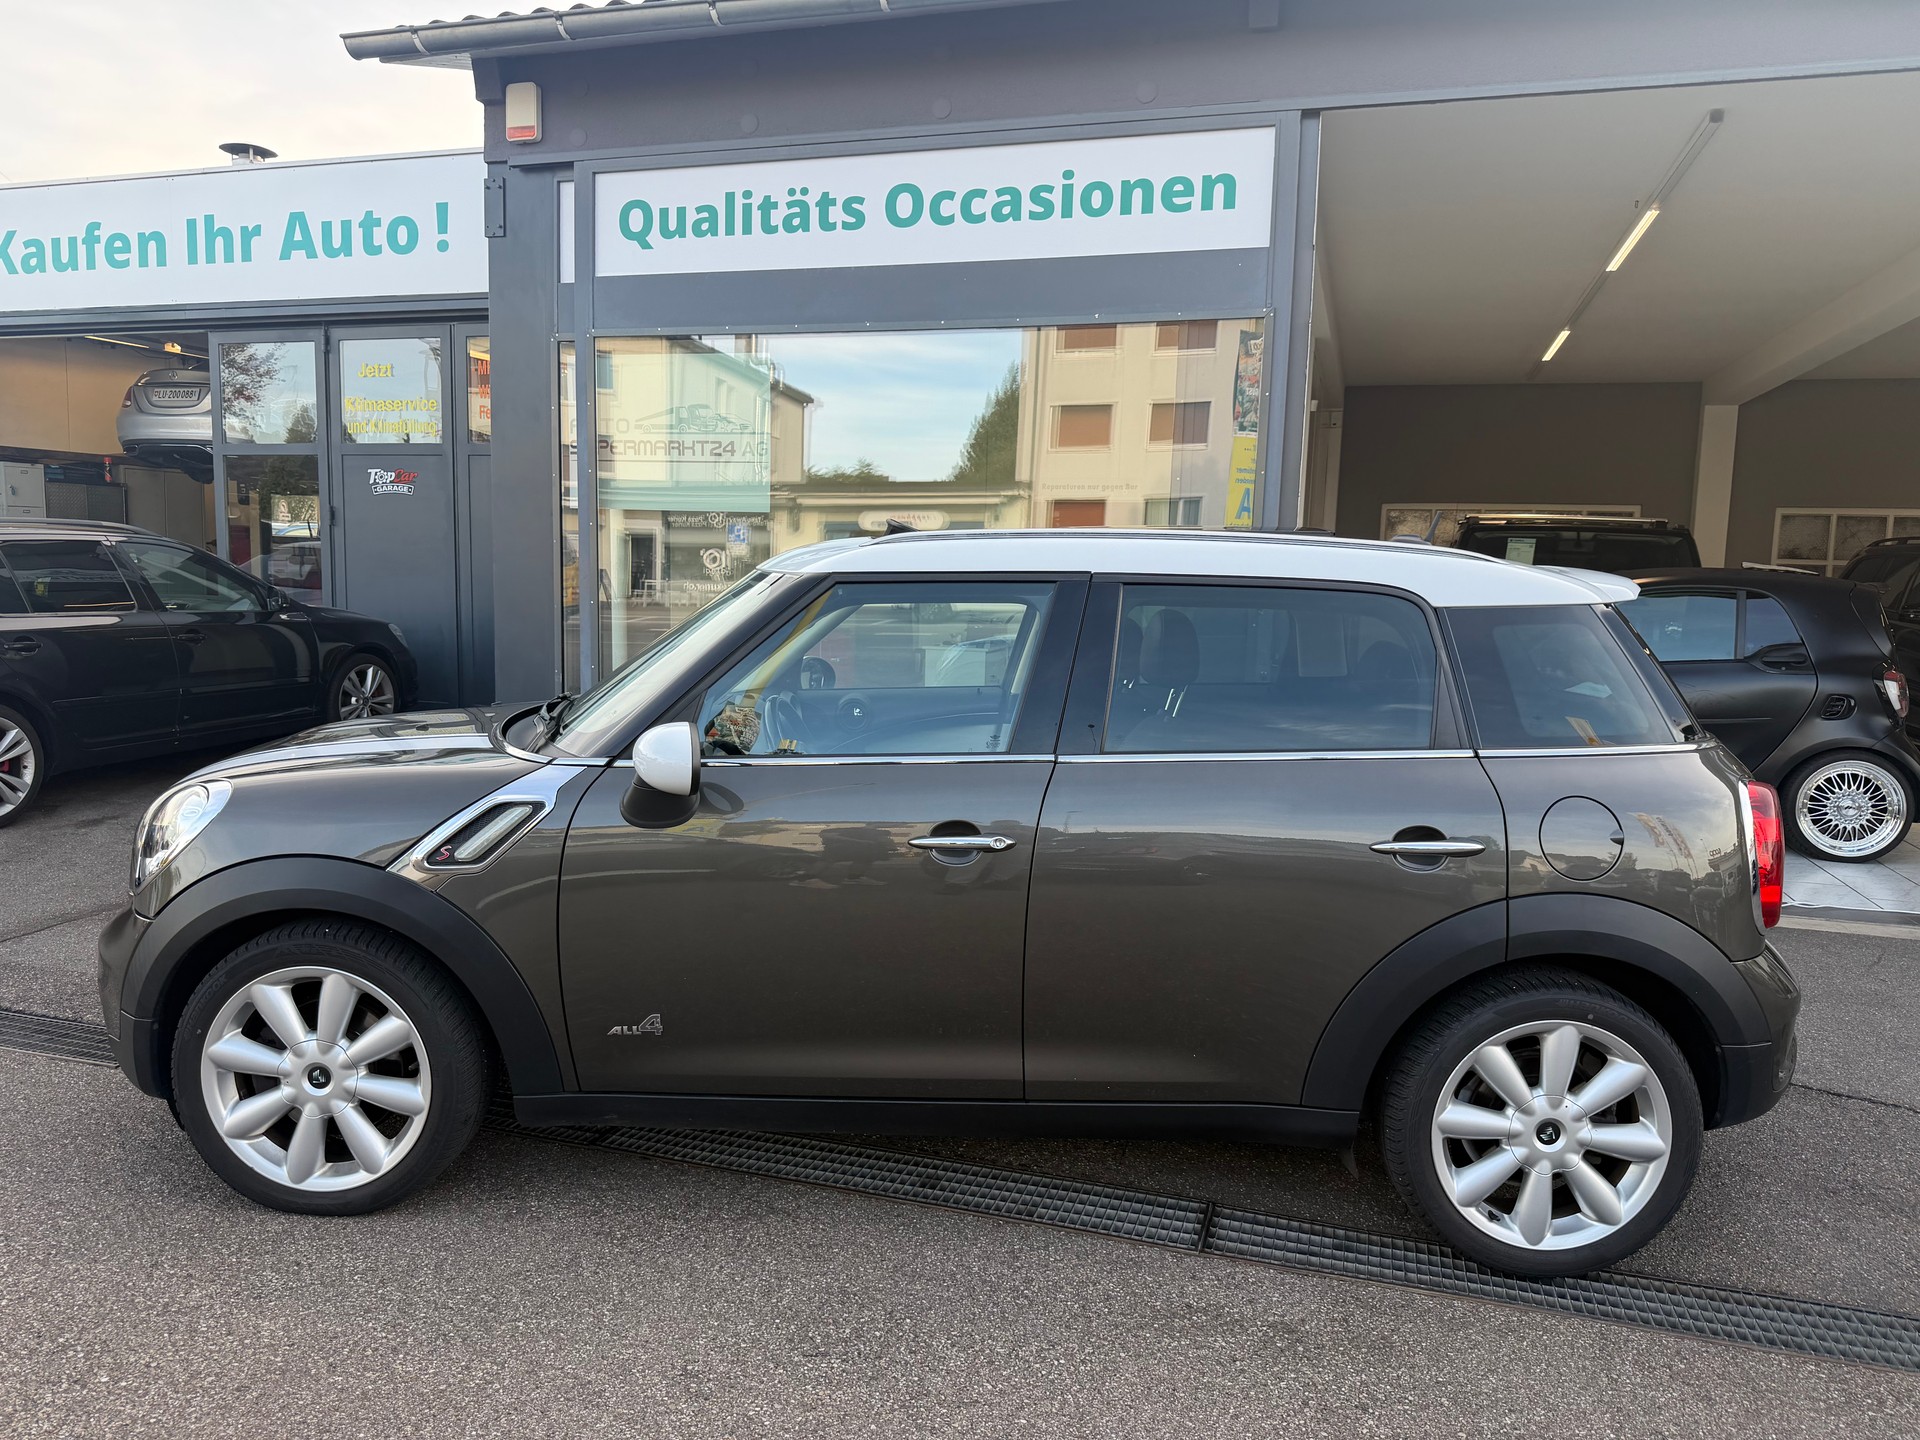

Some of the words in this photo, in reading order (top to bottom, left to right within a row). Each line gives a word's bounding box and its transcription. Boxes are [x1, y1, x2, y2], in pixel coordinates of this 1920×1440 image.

[618, 187, 867, 250] Qualitäts
[884, 169, 1238, 229] Occasionen
[0, 222, 167, 275] Kaufen
[186, 214, 262, 265] Ihr
[279, 210, 419, 261] Auto
[357, 362, 393, 378] Jetzt
[345, 397, 438, 412] Klimaservice
[347, 421, 367, 433] und
[369, 419, 438, 437] Klimafüllung
[377, 485, 408, 493] GARAGE
[436, 845, 452, 862] S
[607, 1014, 663, 1035] ALL4
